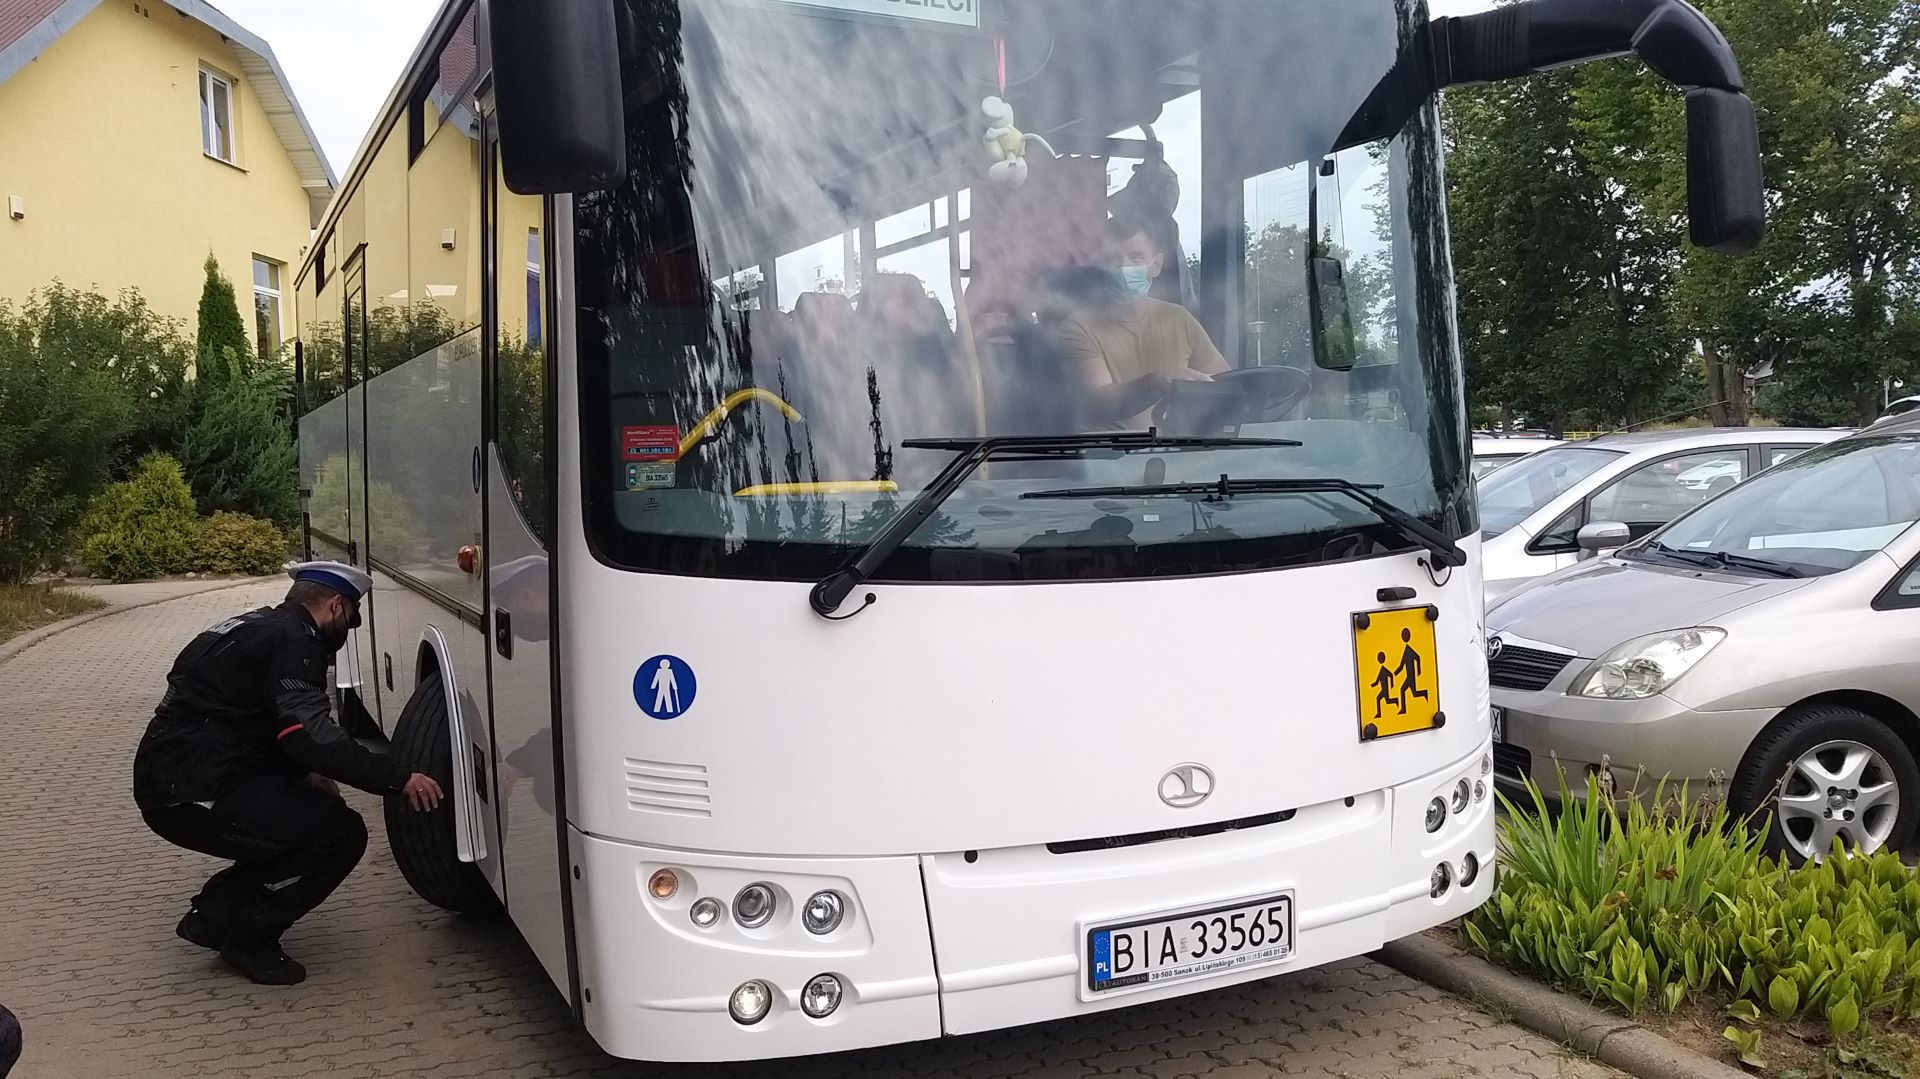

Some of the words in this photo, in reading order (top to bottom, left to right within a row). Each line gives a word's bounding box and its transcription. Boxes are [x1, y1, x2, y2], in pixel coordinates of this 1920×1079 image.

[1114, 926, 1178, 973] BIA
[1190, 906, 1284, 958] 33565
[1096, 962, 1109, 973] PL
[1151, 970, 1173, 980] 38-500
[1174, 967, 1192, 977] Sanok
[1236, 956, 1246, 964] 109
